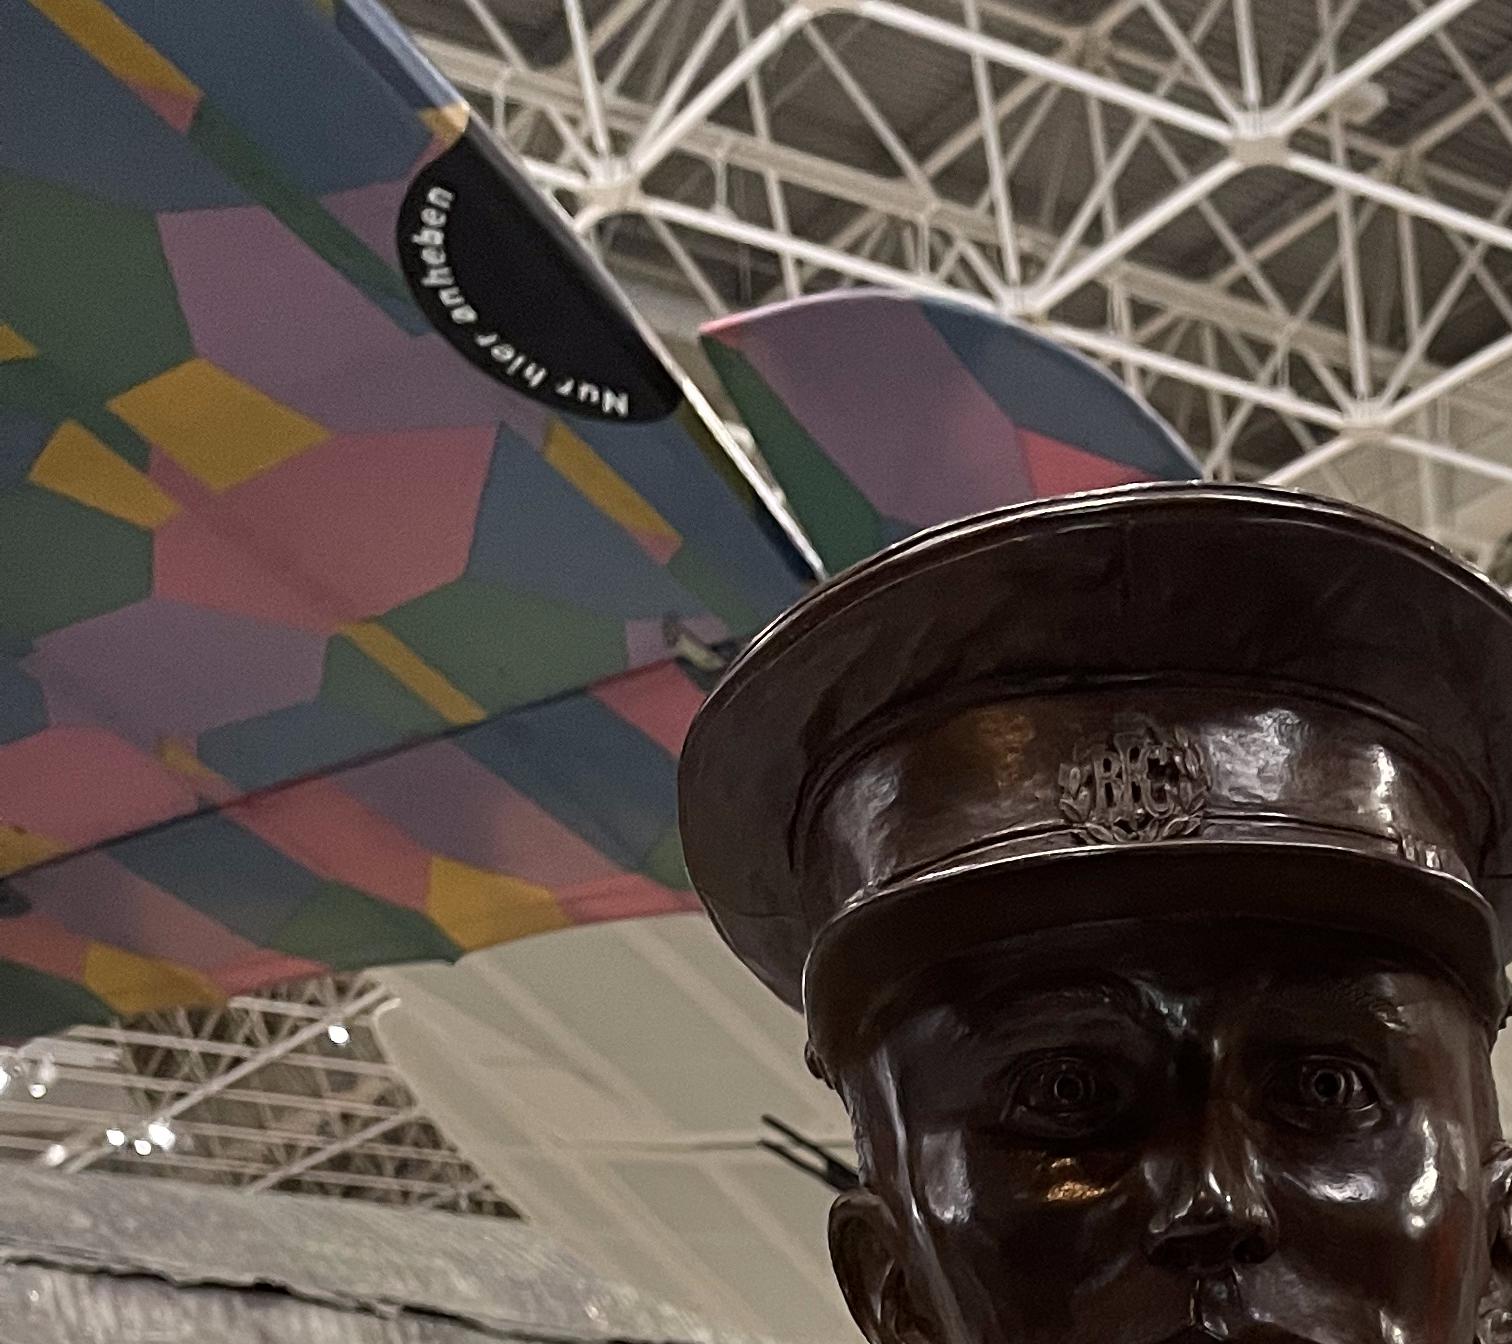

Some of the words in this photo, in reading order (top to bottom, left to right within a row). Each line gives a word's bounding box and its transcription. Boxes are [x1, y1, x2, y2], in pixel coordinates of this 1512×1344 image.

[411, 186, 478, 324] anheben
[473, 333, 548, 388] hier
[554, 376, 630, 417] Nur
